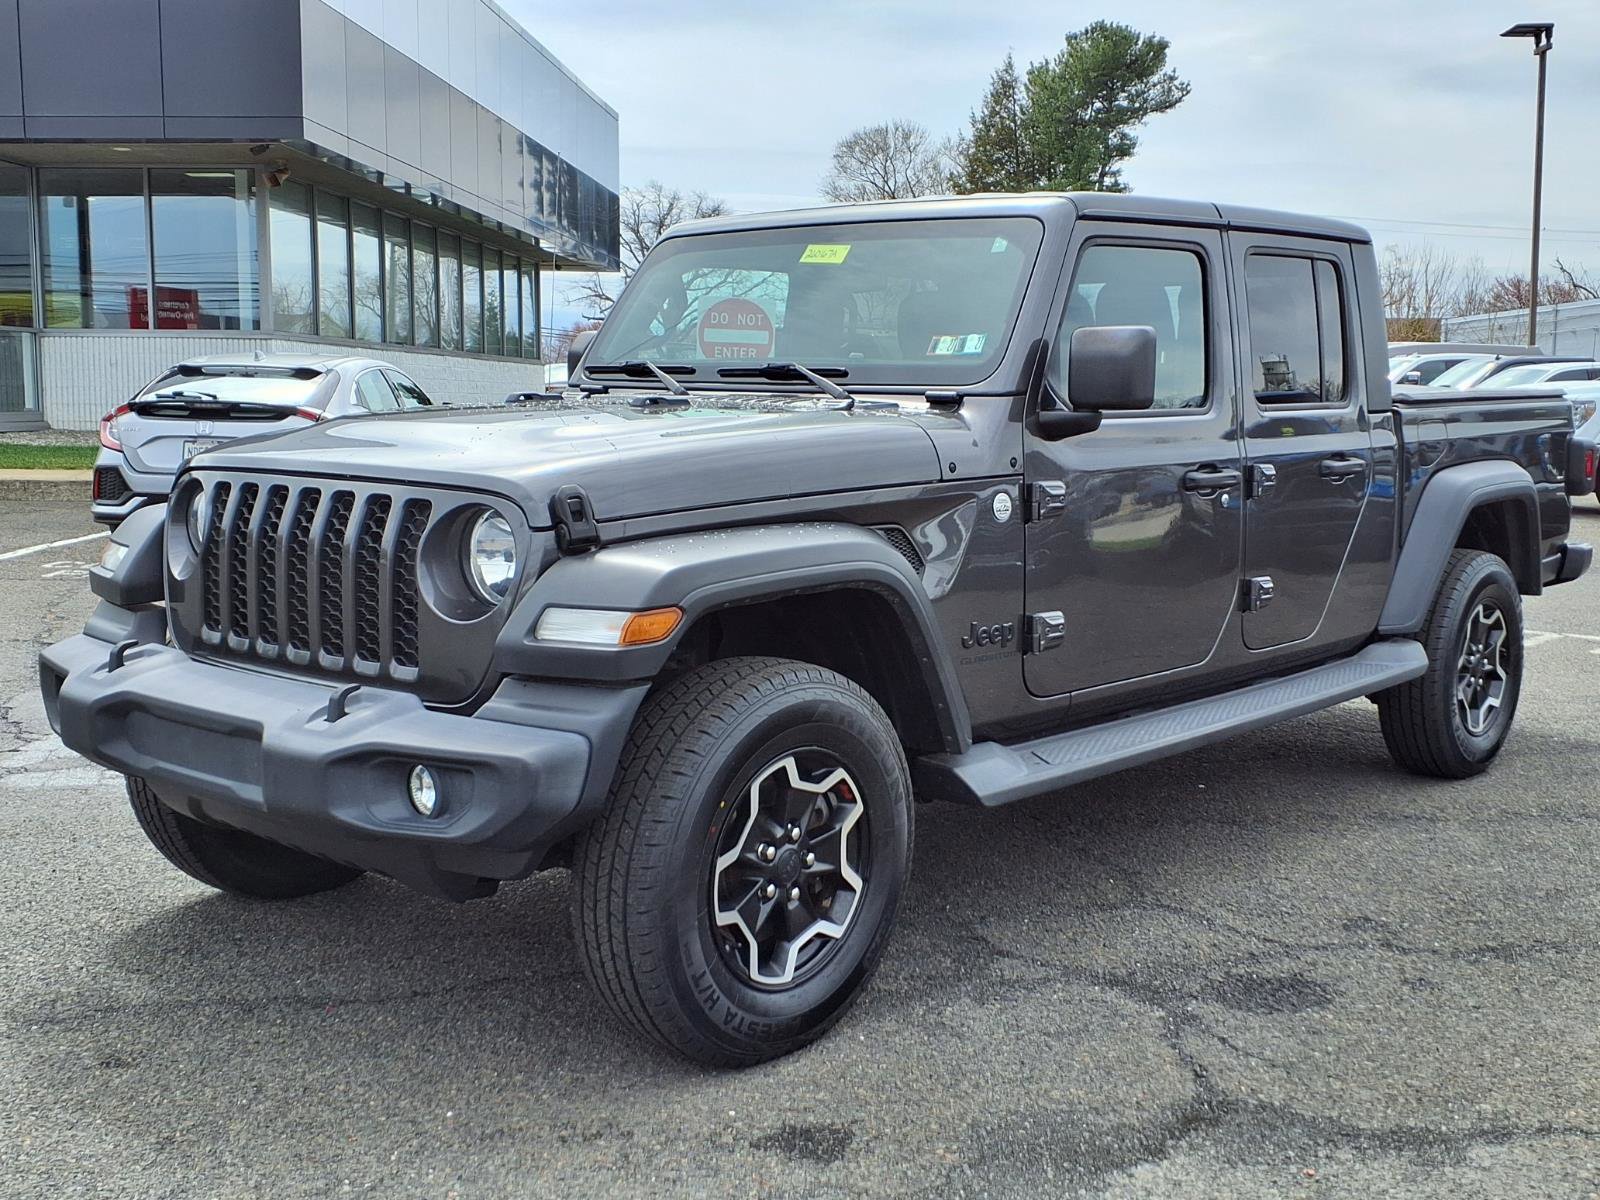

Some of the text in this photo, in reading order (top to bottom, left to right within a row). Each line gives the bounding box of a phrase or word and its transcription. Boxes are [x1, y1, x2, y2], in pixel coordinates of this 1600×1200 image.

[711, 312, 764, 326] DO NOT
[714, 346, 757, 358] ENTER
[961, 621, 1014, 649] Jeep
